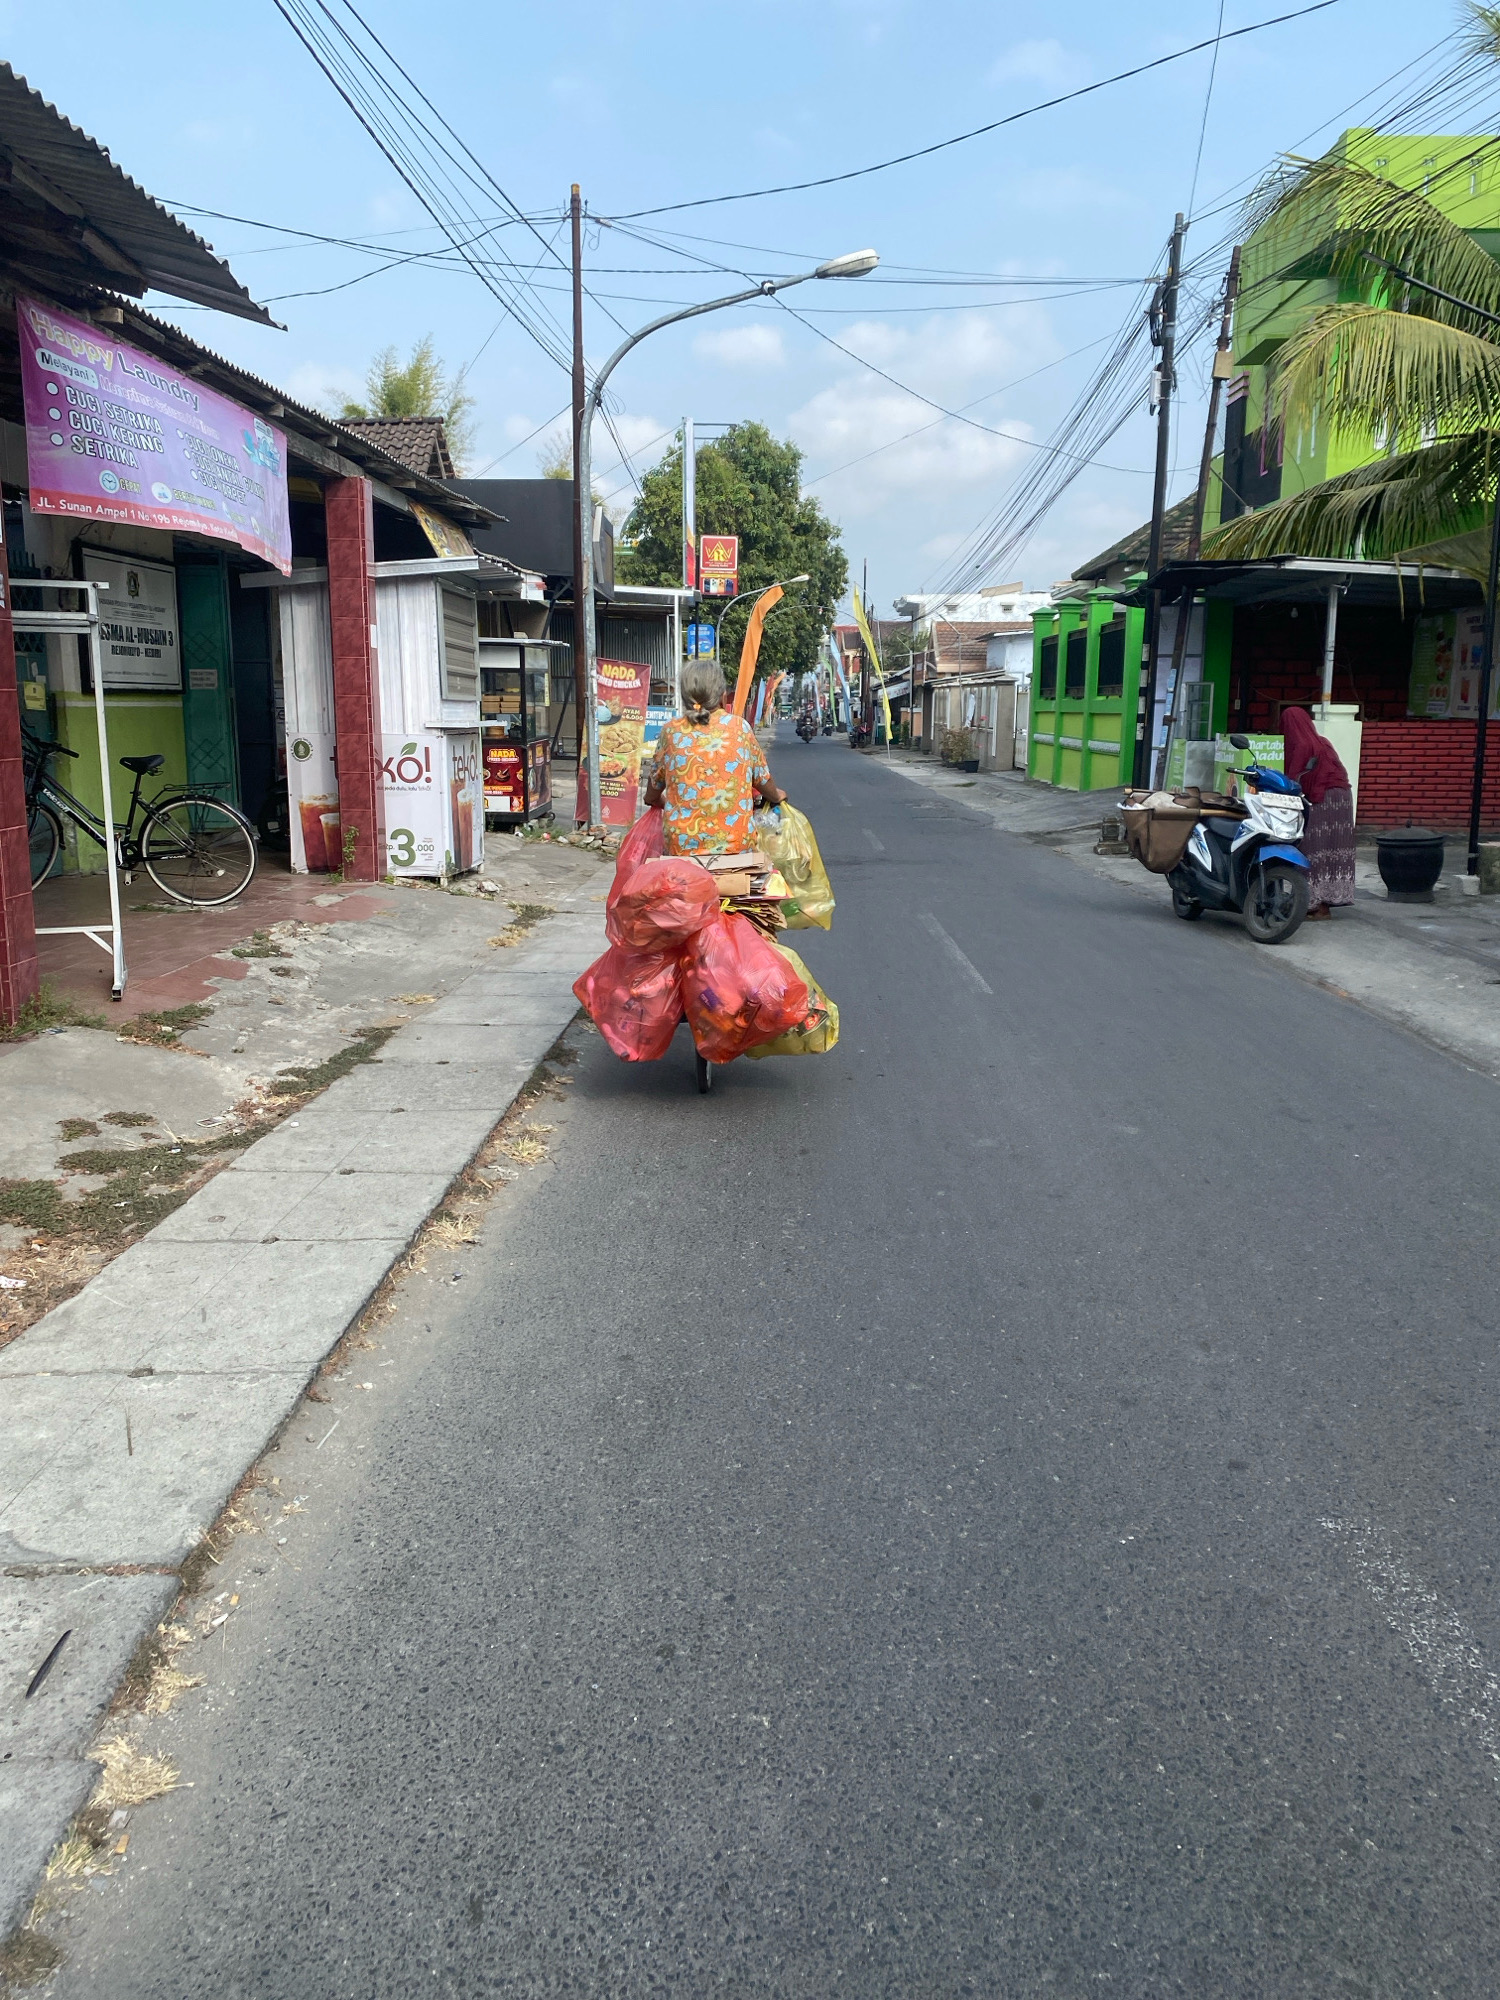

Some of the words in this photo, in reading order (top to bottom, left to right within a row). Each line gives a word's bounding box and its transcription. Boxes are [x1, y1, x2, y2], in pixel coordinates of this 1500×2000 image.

[29, 309, 114, 372] Happy
[117, 352, 199, 413] Laundry
[40, 351, 89, 380] Melayani
[65, 385, 102, 415] CUCI
[103, 400, 164, 436] SETRIKA
[68, 410, 108, 438] CUCI
[108, 422, 164, 454] KERING
[71, 434, 139, 469] SETRIKA
[37, 497, 55, 508] JL.
[59, 499, 92, 513] Sunan
[95, 504, 128, 519] Ampel
[153, 513, 171, 524] 19b
[168, 631, 174, 646] 3
[602, 664, 636, 680] NADA
[613, 678, 642, 689] CHICKEN
[489, 750, 516, 758] NADA
